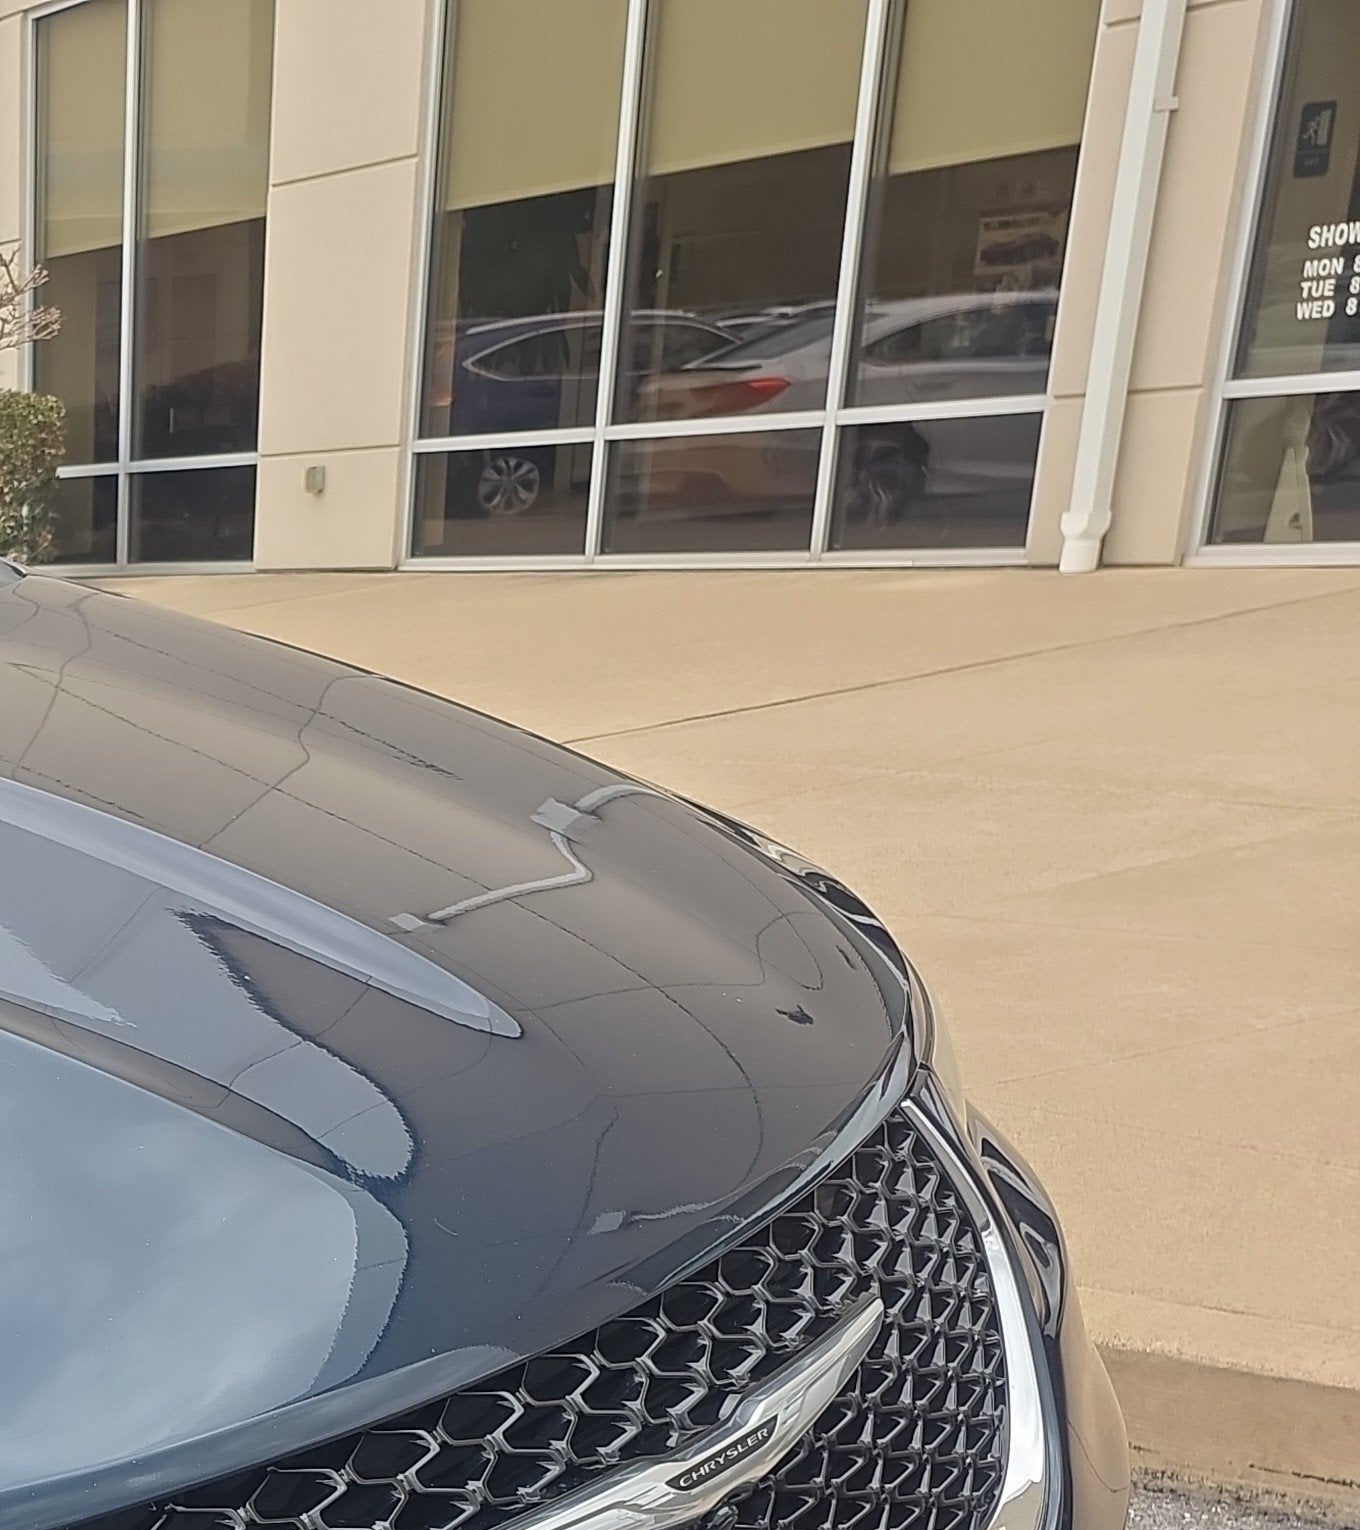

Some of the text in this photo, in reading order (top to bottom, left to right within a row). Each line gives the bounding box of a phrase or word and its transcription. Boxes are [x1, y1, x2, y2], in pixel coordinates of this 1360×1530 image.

[1302, 256, 1345, 278] MON
[1300, 278, 1337, 299] TUE
[1296, 299, 1335, 320] WED
[679, 1427, 769, 1487] CHRYSLER
